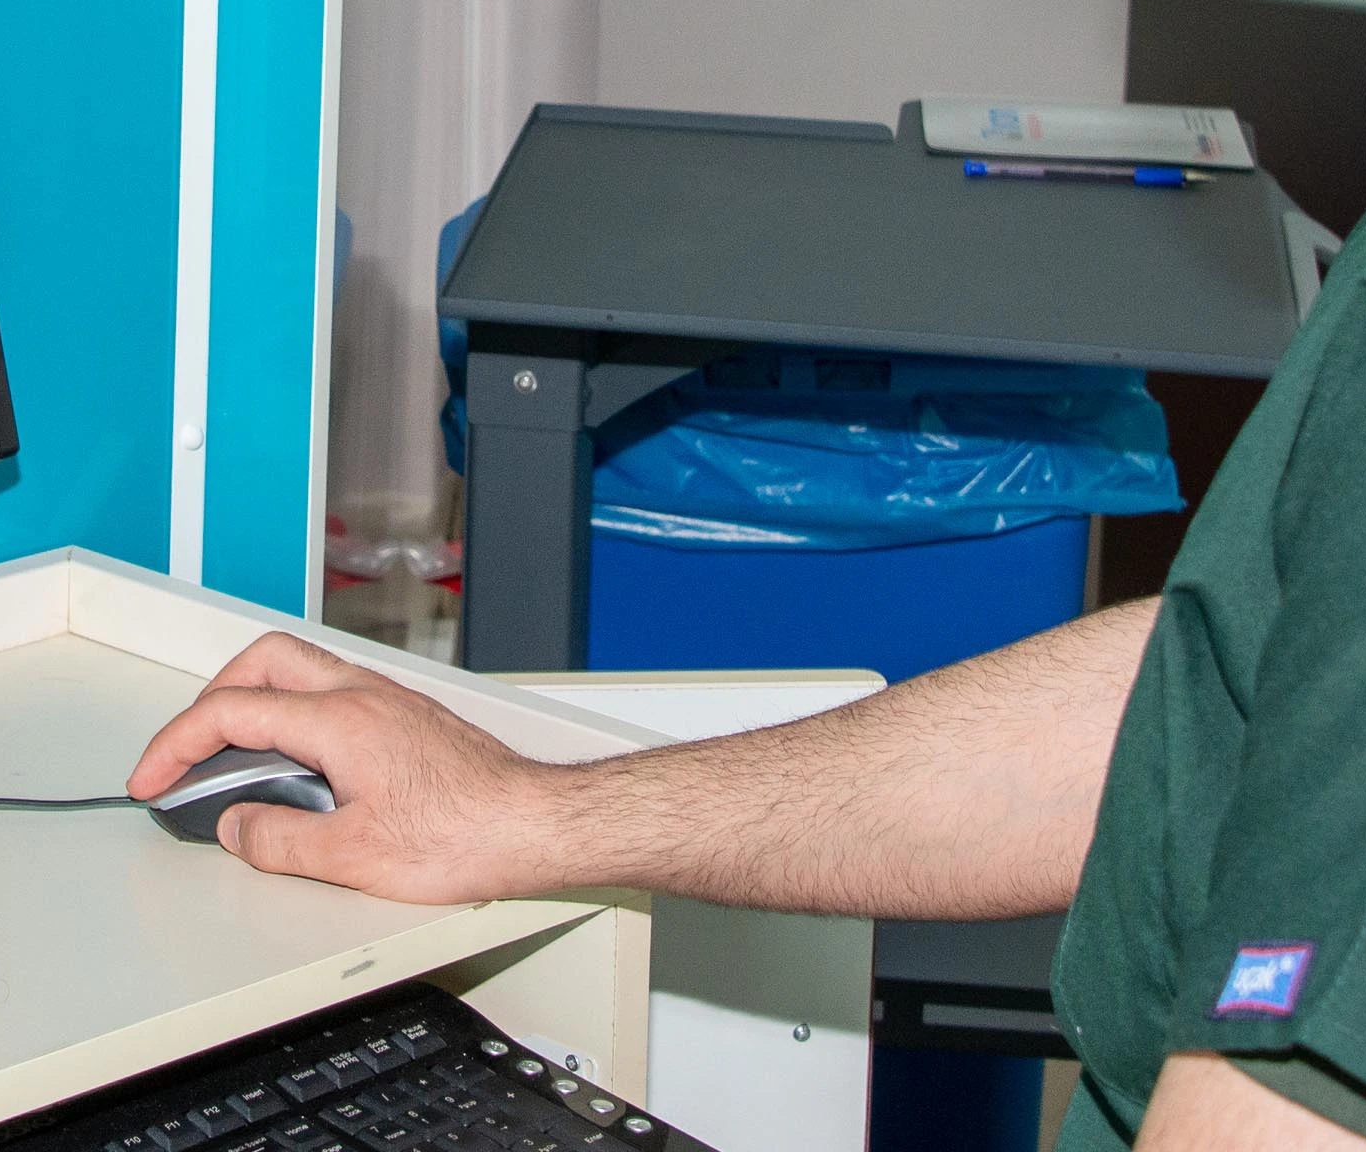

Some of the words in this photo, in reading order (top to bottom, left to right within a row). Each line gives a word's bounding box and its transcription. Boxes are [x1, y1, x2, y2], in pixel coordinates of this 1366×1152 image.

[242, 1088, 265, 1102] Insert
[203, 1106, 221, 1118] F12
[164, 1120, 181, 1132] F11
[285, 1124, 309, 1136] Home
[124, 1135, 141, 1148] F10
